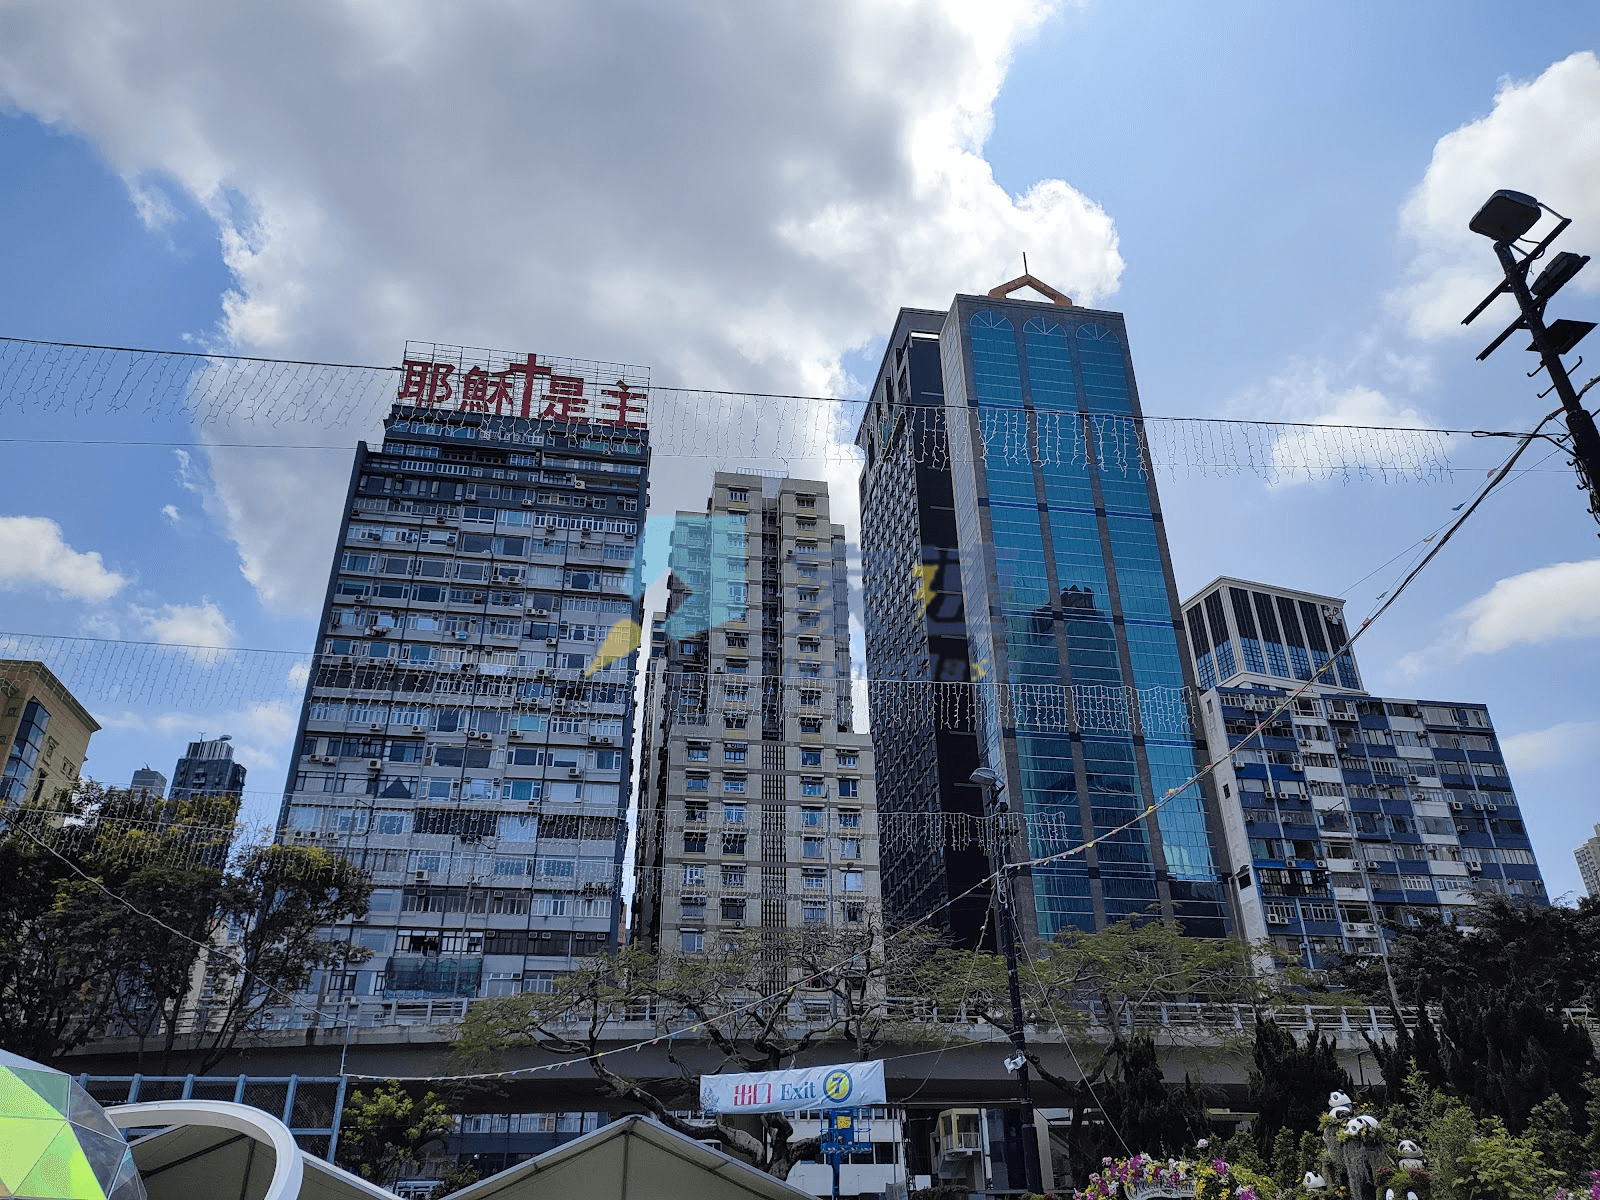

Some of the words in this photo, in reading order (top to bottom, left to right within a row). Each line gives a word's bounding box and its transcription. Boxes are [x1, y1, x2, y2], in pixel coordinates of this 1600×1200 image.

[733, 1083, 772, 1106] 出口
[780, 1081, 816, 1101] Exit
[831, 1076, 843, 1095] 7
